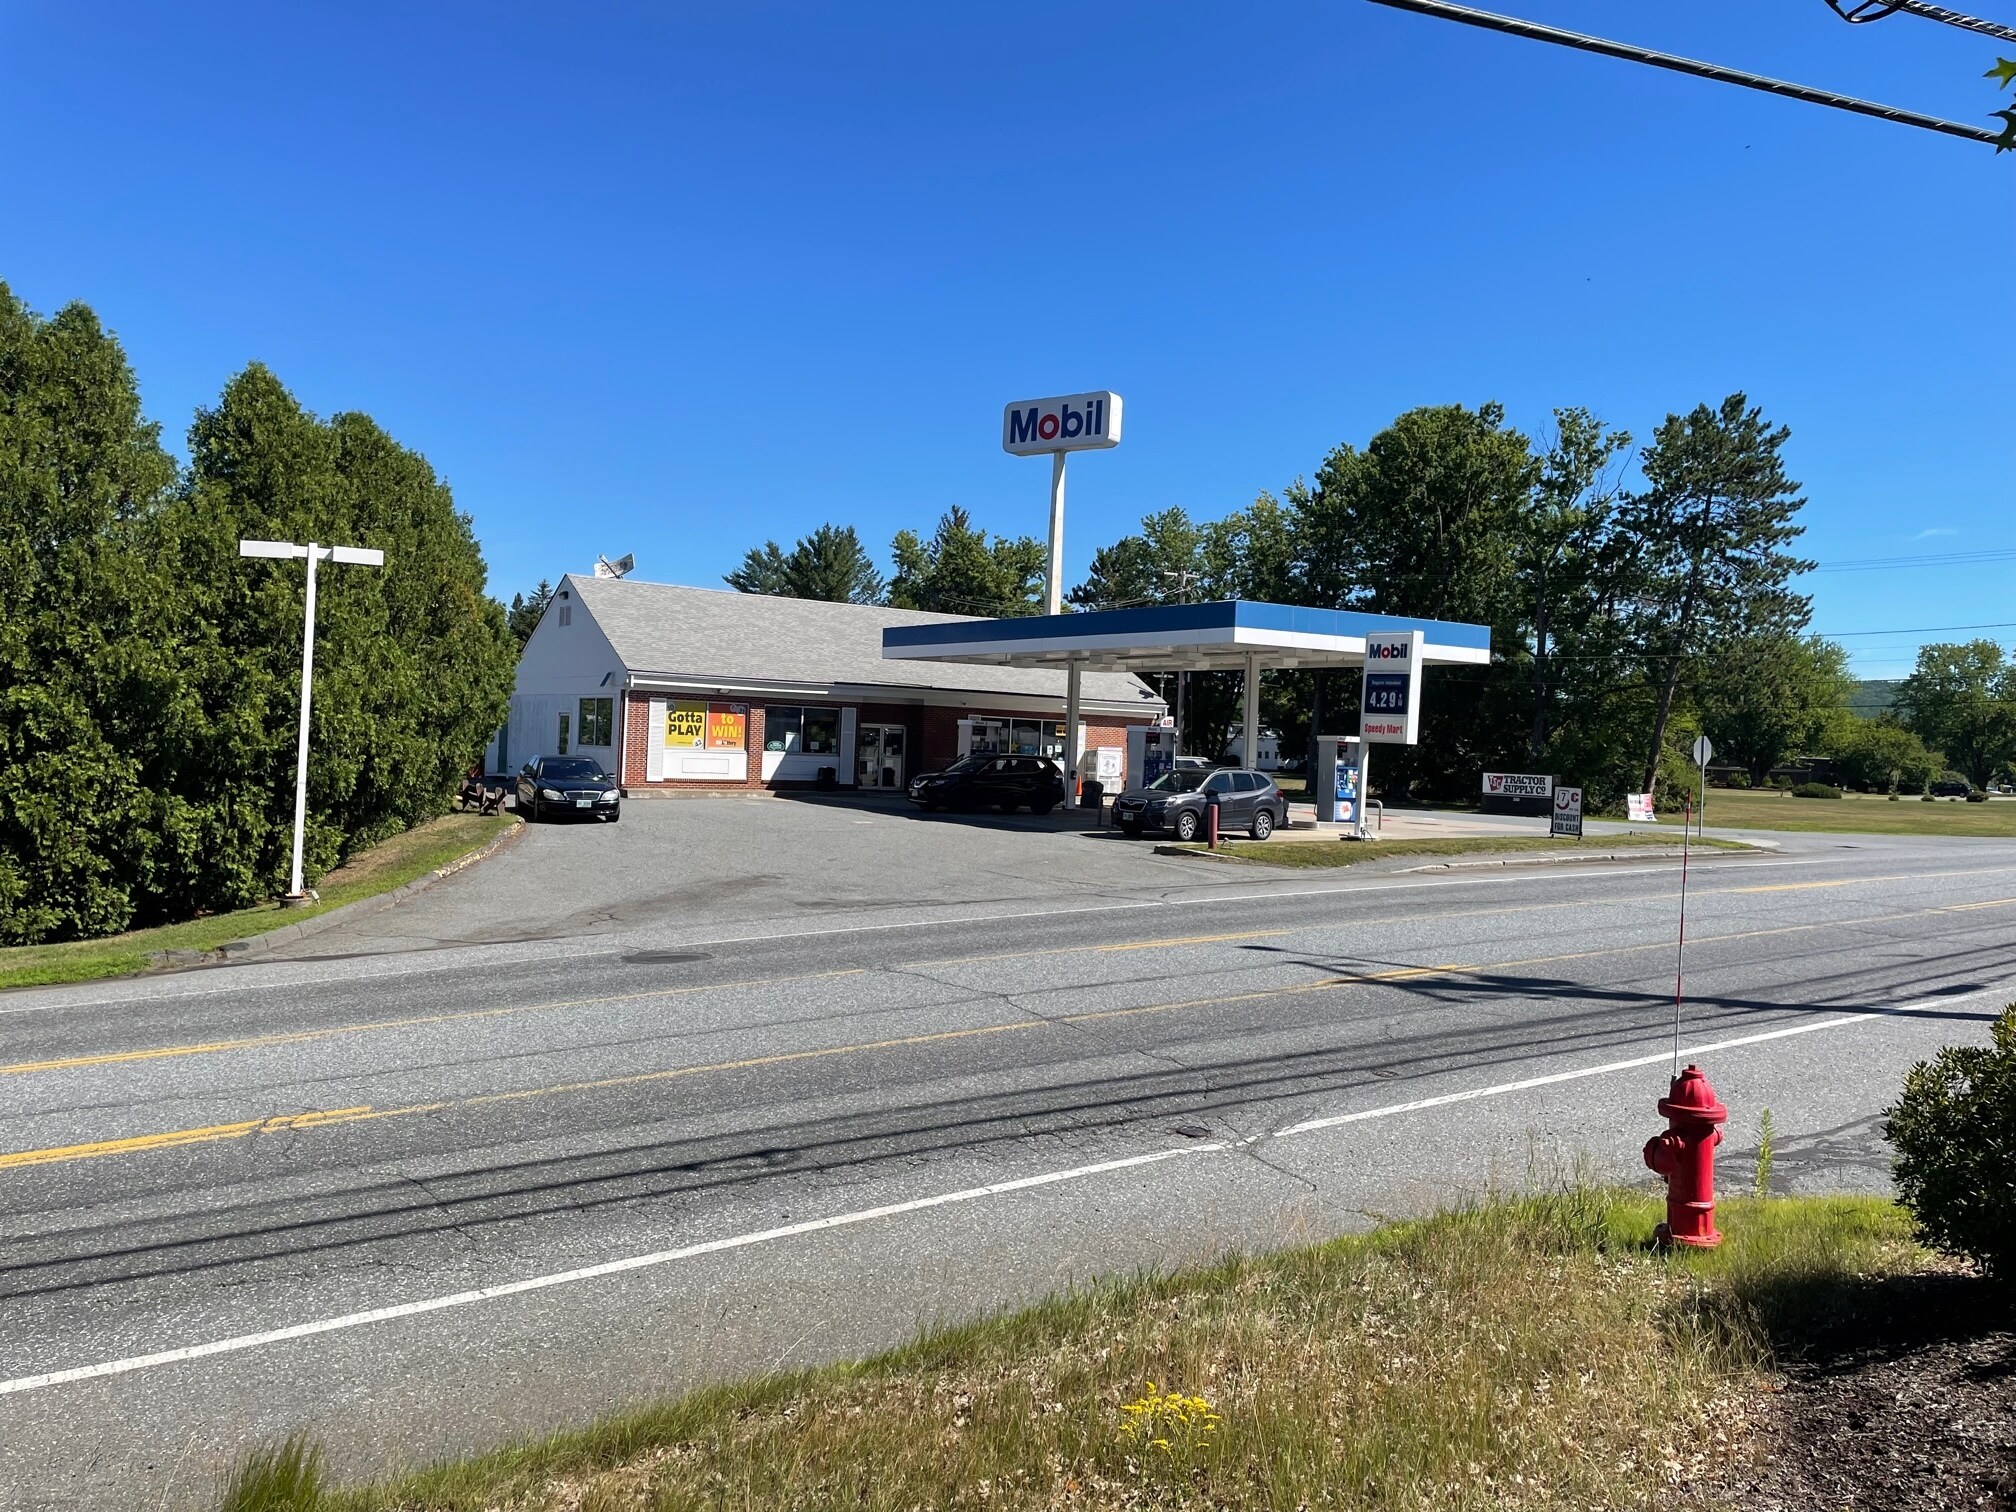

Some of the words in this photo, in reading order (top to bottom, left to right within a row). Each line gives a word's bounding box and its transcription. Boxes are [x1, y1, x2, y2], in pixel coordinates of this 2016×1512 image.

[1010, 400, 1103, 444] Mobil
[1369, 644, 1408, 658] Mobil
[1370, 692, 1396, 707] 4.29
[668, 712, 702, 723] Gotta
[721, 713, 734, 724] to
[668, 724, 702, 736] PLAY
[712, 725, 742, 738] WIN!
[1364, 723, 1386, 734] Speedy
[1387, 724, 1403, 734] Mart
[1489, 776, 1502, 789] TSC
[1504, 775, 1546, 785] TRACTOR
[1503, 785, 1536, 795] SUPPLY
[1555, 813, 1579, 822] DISCOUNT
[1566, 824, 1578, 832] CASH
